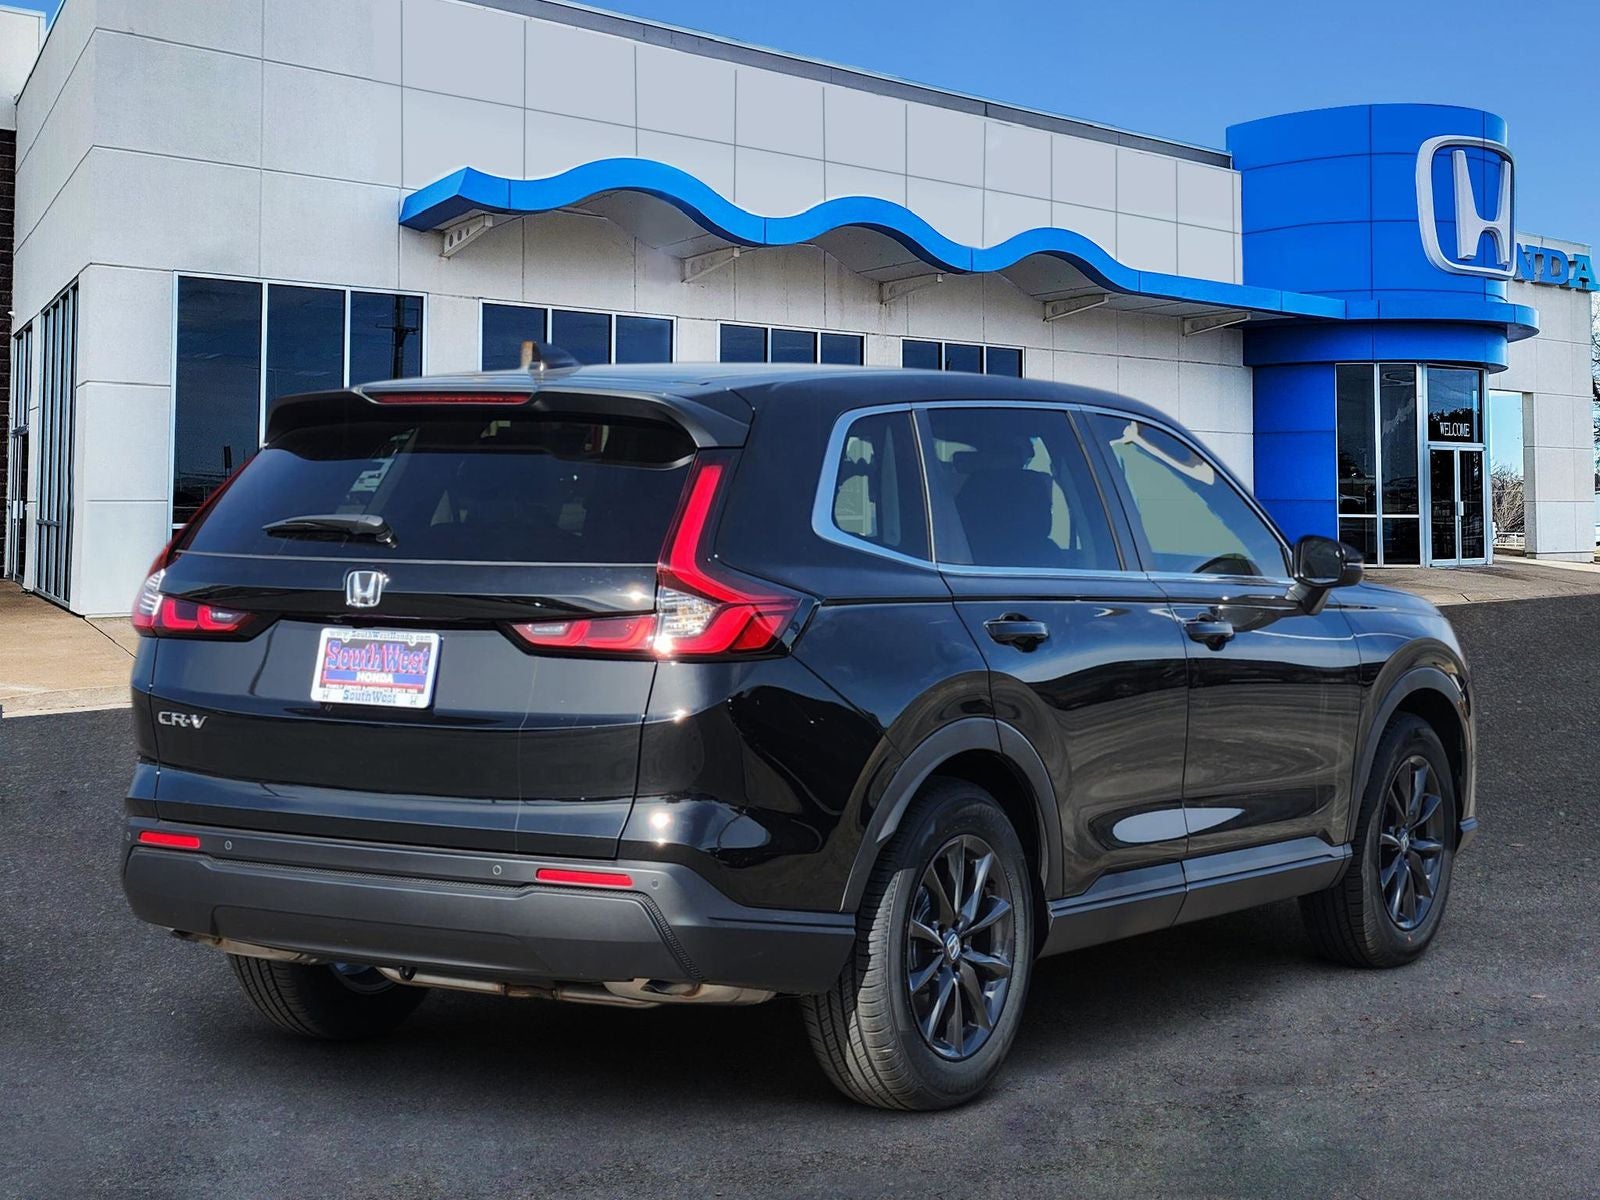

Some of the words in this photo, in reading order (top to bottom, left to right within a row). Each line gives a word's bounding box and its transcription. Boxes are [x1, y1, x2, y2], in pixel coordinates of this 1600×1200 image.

[1515, 242, 1600, 292] NDA
[1440, 422, 1471, 437] WELCOME
[356, 671, 394, 684] HONDA
[158, 711, 208, 729] CR-V
